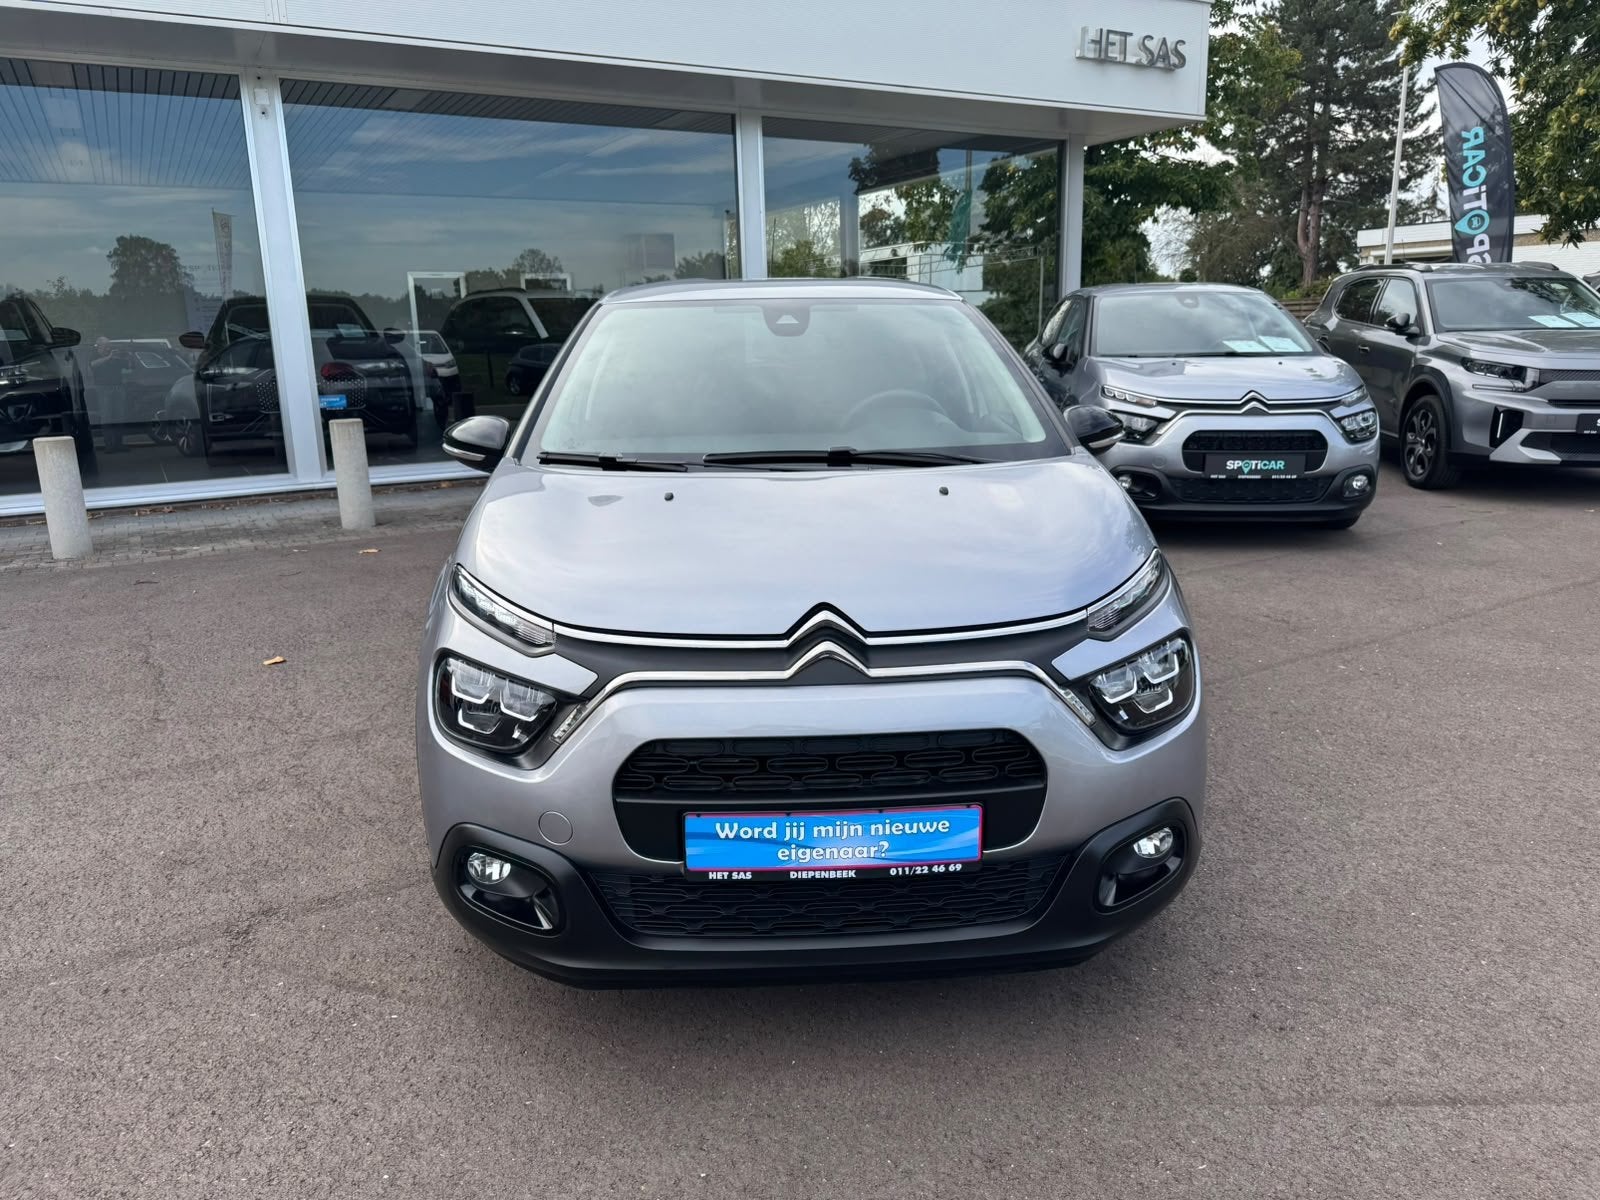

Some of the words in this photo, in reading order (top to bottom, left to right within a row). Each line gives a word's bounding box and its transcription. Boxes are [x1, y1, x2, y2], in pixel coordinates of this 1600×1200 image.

[1080, 26, 1133, 62] HET
[1138, 35, 1187, 69] SAS
[715, 821, 778, 840] Word
[783, 821, 806, 842] jij
[813, 820, 864, 841] mijn
[870, 818, 951, 836] nieuwe
[777, 841, 889, 862] eigenaar?
[708, 871, 729, 880] HET
[731, 871, 752, 880] SAS
[790, 869, 857, 879] DIEPENBEEK
[889, 864, 929, 876] 011/22
[931, 863, 947, 874] 46
[948, 862, 963, 873] 69
